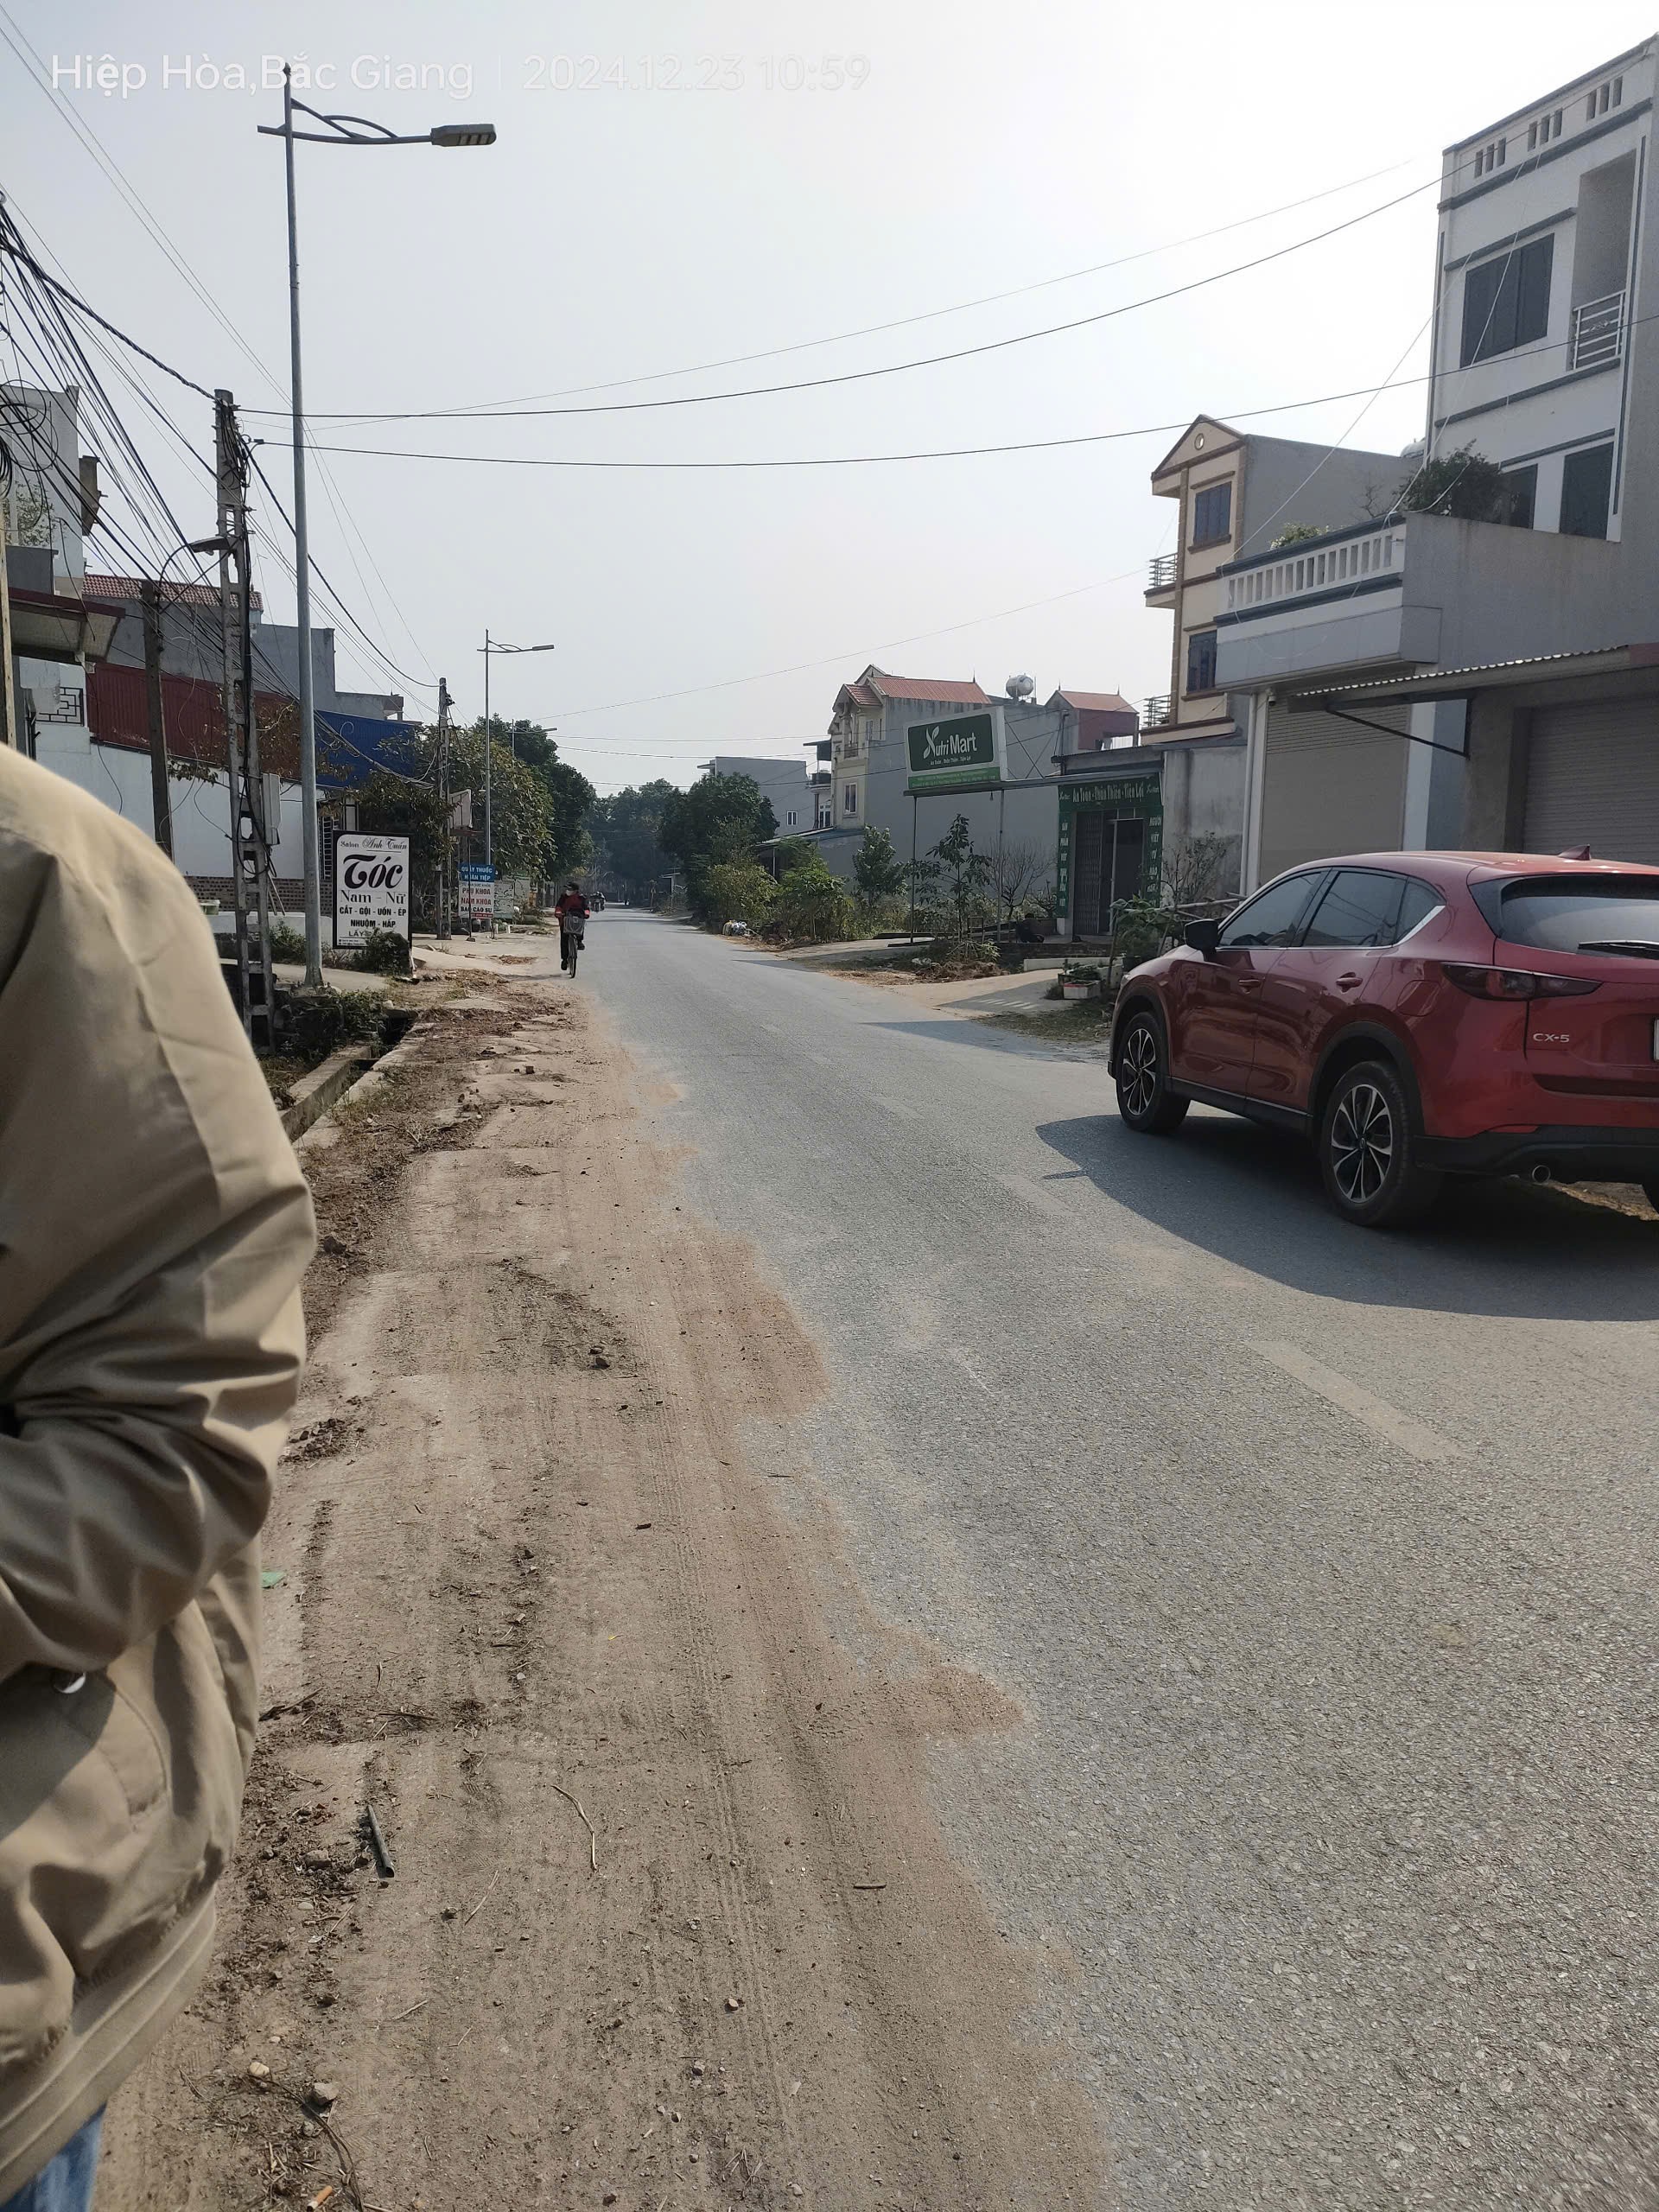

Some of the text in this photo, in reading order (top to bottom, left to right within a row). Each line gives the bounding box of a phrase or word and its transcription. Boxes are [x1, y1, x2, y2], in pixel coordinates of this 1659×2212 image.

[343, 854, 403, 889] Tóc
[340, 890, 371, 903] Nam
[386, 892, 406, 904] Nữ
[359, 906, 371, 917] GỘI
[377, 907, 391, 916] UỐN
[1533, 1033, 1570, 1043] CX-5
